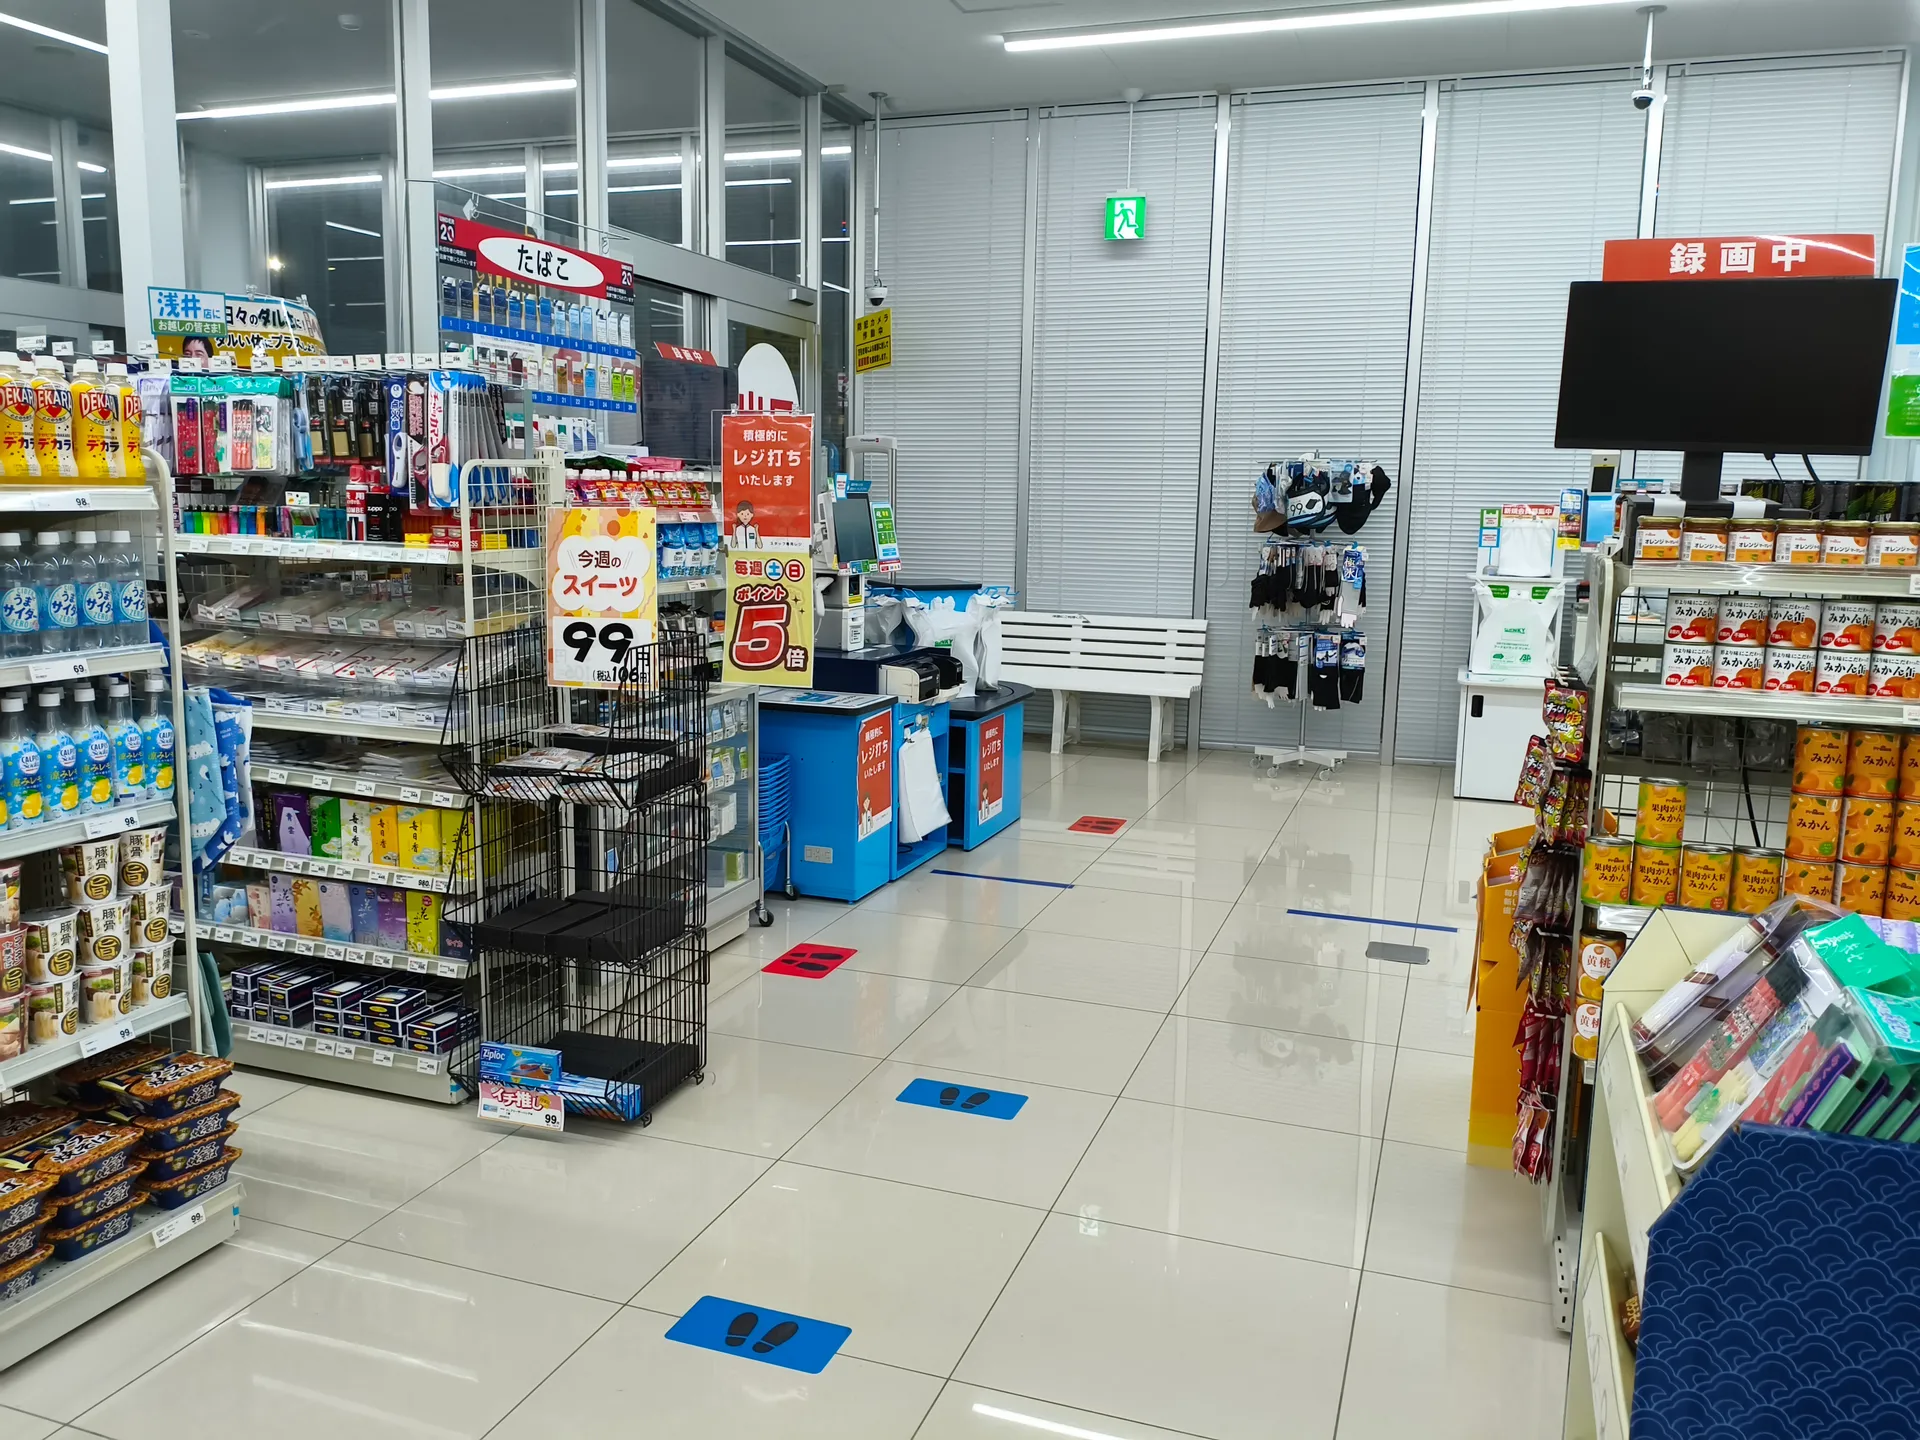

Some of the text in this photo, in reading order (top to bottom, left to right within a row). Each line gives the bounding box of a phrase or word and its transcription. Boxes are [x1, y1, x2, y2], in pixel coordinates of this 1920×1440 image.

[440, 224, 455, 242] 20
[517, 244, 569, 281] たばこ
[1668, 241, 1808, 275] 録画中
[621, 271, 633, 286] 20
[157, 292, 222, 320] 浅井店に
[0, 387, 34, 412] DEKAR
[743, 429, 788, 442] 積極的に
[38, 438, 72, 451] デカラ
[86, 439, 120, 453] デカラ
[127, 441, 140, 453] デ
[733, 448, 801, 467] レジ打ち
[739, 474, 795, 487] いたします
[75, 497, 88, 507] 98
[577, 549, 622, 569] 今週の
[563, 574, 638, 597] スイーツ
[736, 585, 787, 602] ポイント
[52, 600, 77, 617] サイダ
[86, 597, 113, 613] サイダ
[122, 595, 146, 611] サイダ
[1828, 612, 1871, 625] みかん缶
[73, 664, 85, 674] 69
[1823, 661, 1867, 675] みかん缶
[1872, 664, 1916, 678] みかん缶
[864, 725, 884, 743] 積極的に
[861, 739, 889, 765] レジ打ち
[982, 739, 1002, 758] レジ打ち
[983, 756, 1000, 772] いたします
[1810, 752, 1844, 765] みかん
[1862, 755, 1897, 768] みかん
[863, 760, 887, 780] いたします
[124, 816, 136, 827] 98
[1655, 812, 1683, 824] みかん
[1796, 817, 1832, 831] みかん
[349, 812, 360, 847] 毎日香
[408, 820, 420, 853] 毎日香
[129, 834, 143, 858] 豚骨
[95, 846, 108, 870] 豚骨
[125, 861, 147, 884] 旨
[1598, 872, 1626, 883] みかん
[1642, 875, 1671, 886] みかん
[1685, 869, 1727, 883] 果肉が大粒
[88, 874, 109, 897] 旨
[1688, 879, 1718, 892] みかん
[1746, 884, 1776, 895] みかん
[155, 891, 167, 914] 豚骨
[1886, 890, 1920, 906] みかん
[102, 907, 116, 932] 豚骨
[60, 920, 73, 946] 豚骨
[147, 918, 167, 940] 旨
[96, 935, 119, 958] 旨
[51, 950, 73, 974] 旨
[163, 948, 172, 971] 豚骨
[1586, 953, 1612, 970] 黄桃
[4, 968, 23, 991] 旨
[155, 974, 172, 998] 旨
[65, 1007, 79, 1032] 旨
[119, 1028, 131, 1039] 99
[482, 1048, 506, 1061] Ziploc
[491, 1086, 544, 1111] イチ推し
[544, 1113, 557, 1125] 99
[191, 1212, 201, 1223] 99
